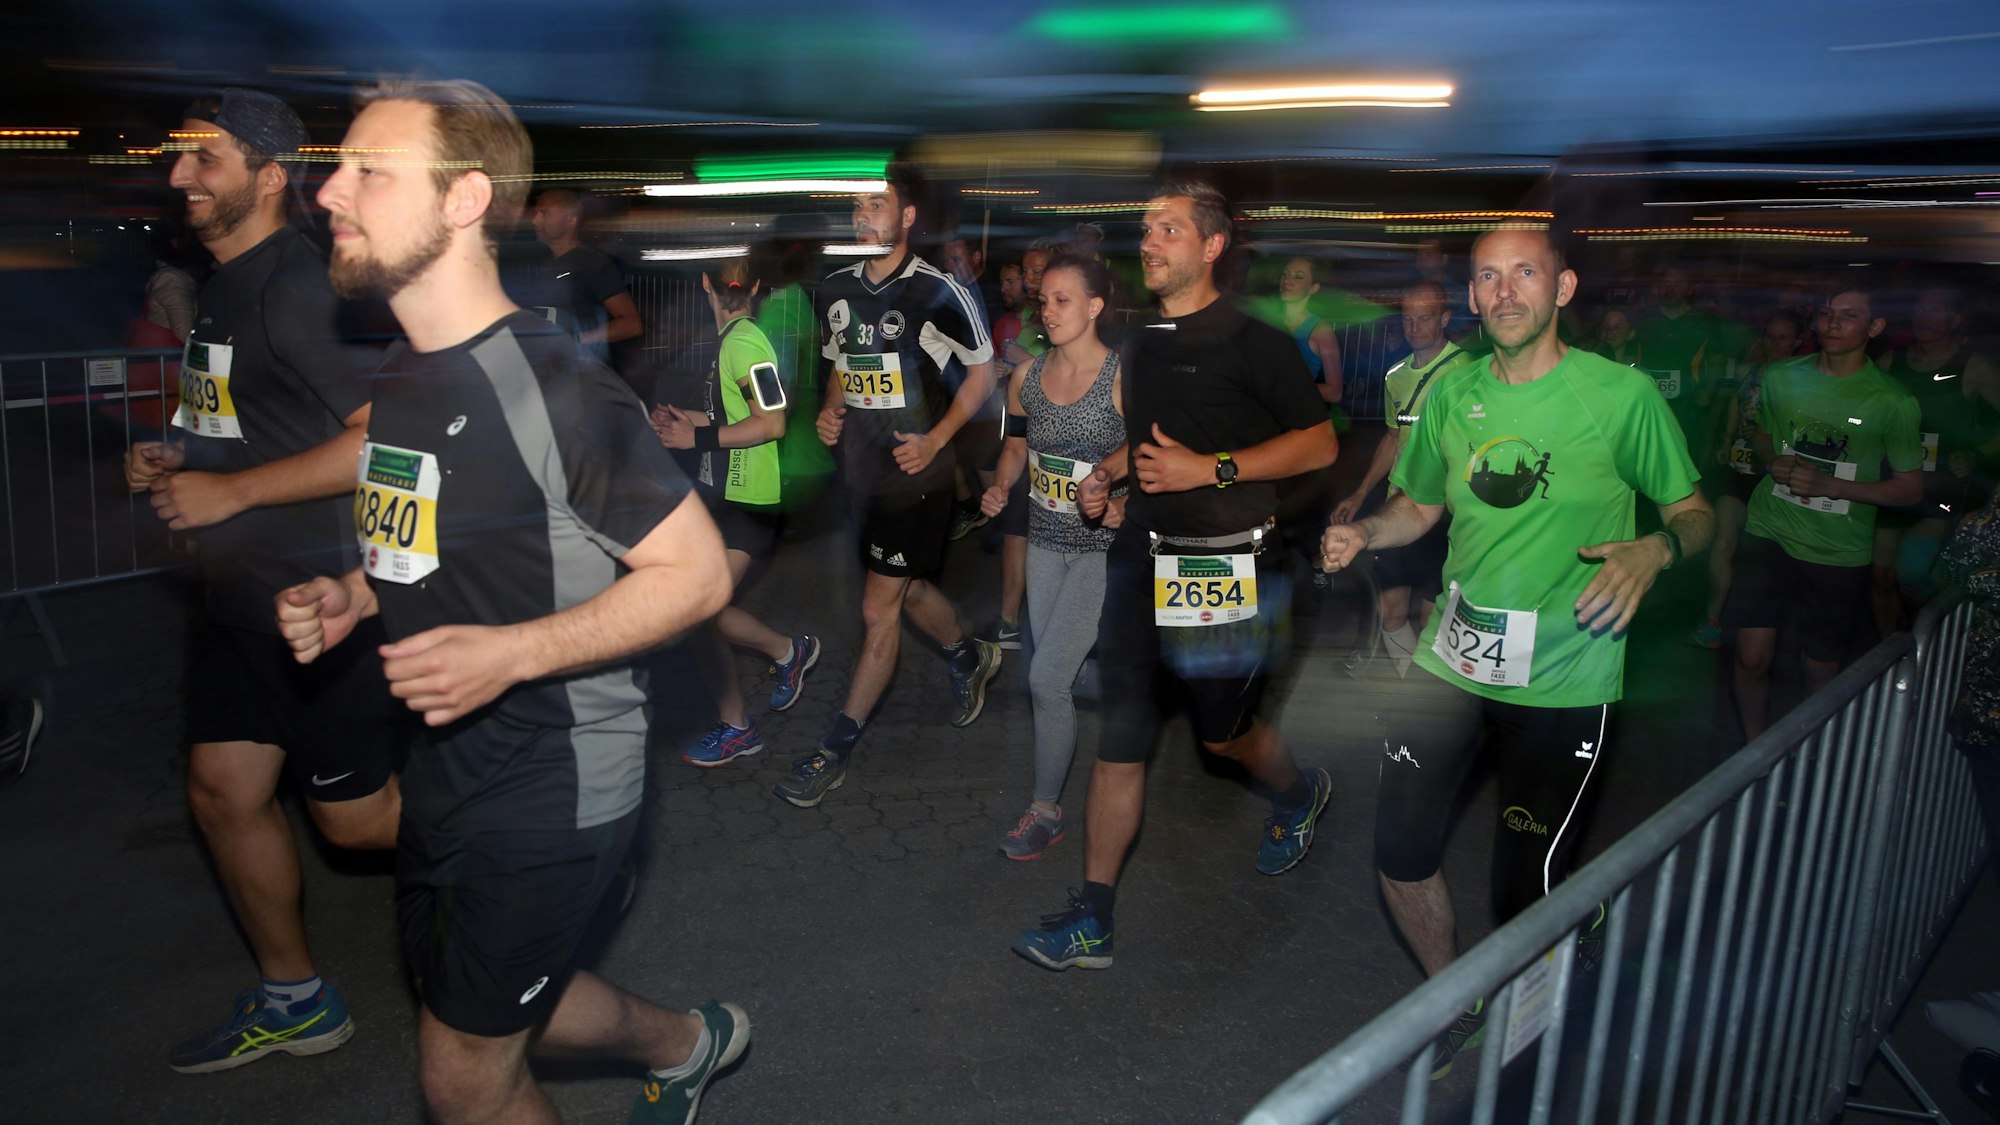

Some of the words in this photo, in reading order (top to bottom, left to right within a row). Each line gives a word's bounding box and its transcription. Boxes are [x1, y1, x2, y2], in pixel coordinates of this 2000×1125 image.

[857, 324, 874, 345] 33
[183, 371, 219, 413] 2839
[843, 373, 893, 394] 2915
[1033, 467, 1078, 502] 2916
[1166, 580, 1245, 607] 2654
[1447, 617, 1506, 668] 524
[1507, 812, 1548, 836] GALERIA
